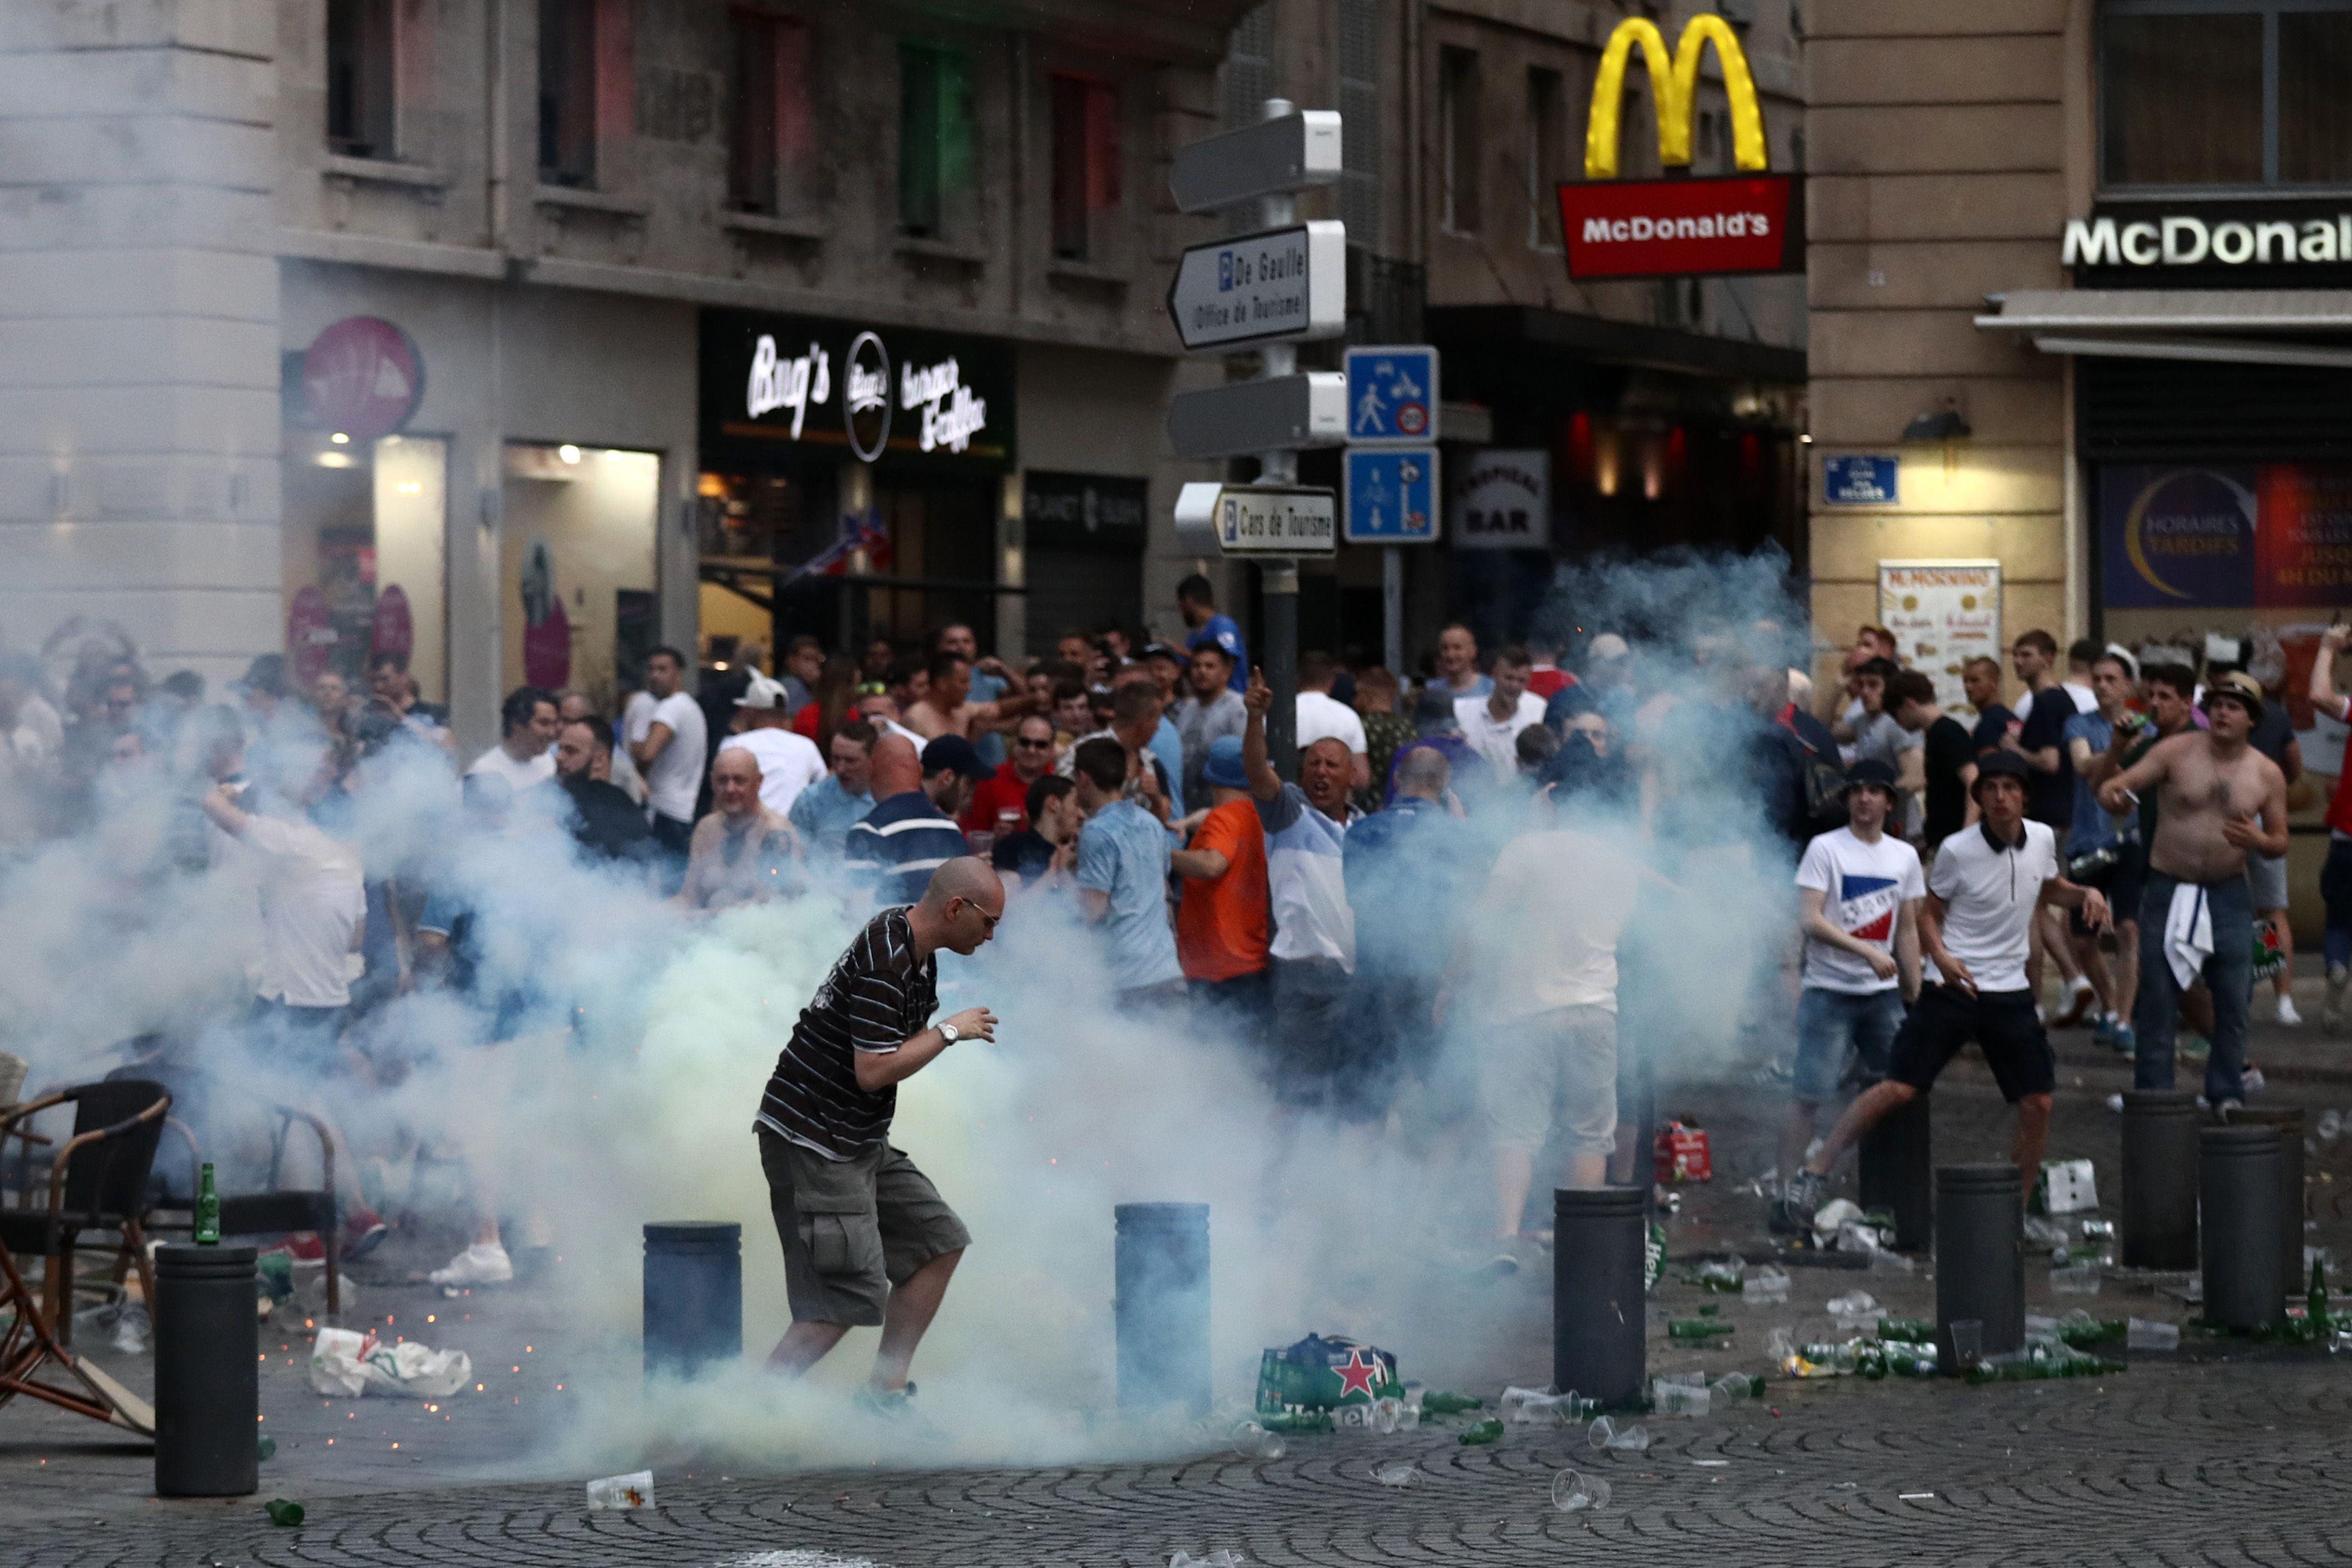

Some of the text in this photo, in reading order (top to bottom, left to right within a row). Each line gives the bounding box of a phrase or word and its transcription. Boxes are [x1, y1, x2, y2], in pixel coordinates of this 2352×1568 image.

[1582, 211, 1770, 243] McDonald's
[1236, 256, 1251, 286] De
[1259, 248, 1304, 281] Gaulle
[1234, 299, 1246, 323] de
[1253, 295, 1301, 321] Tourisme
[1239, 505, 1264, 536] Cars
[1269, 506, 1281, 536] de
[1288, 506, 1331, 537] Tourisme
[1466, 510, 1530, 533] BAR
[2146, 514, 2239, 535] HORAIRES
[2150, 536, 2238, 555] TARDIFS
